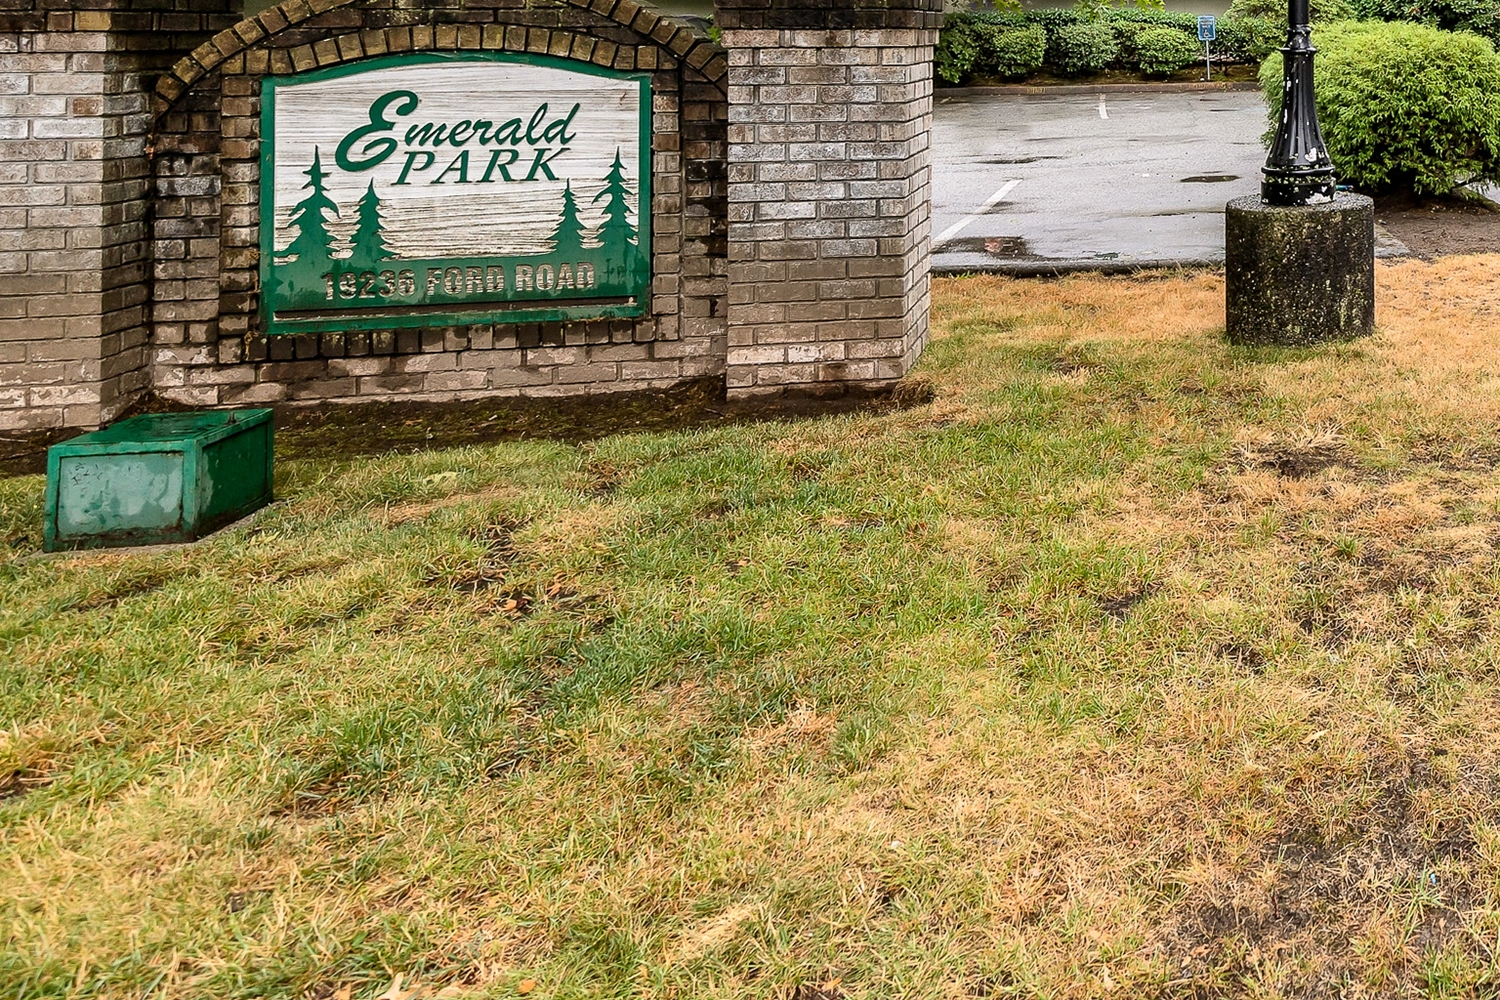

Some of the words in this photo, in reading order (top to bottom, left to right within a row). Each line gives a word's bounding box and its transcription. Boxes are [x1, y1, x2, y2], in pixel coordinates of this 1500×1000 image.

[335, 90, 580, 172] Emerald
[391, 147, 571, 186] PARK
[321, 269, 416, 301] 19236
[426, 265, 505, 296] FORD
[515, 262, 595, 292] ROAD
